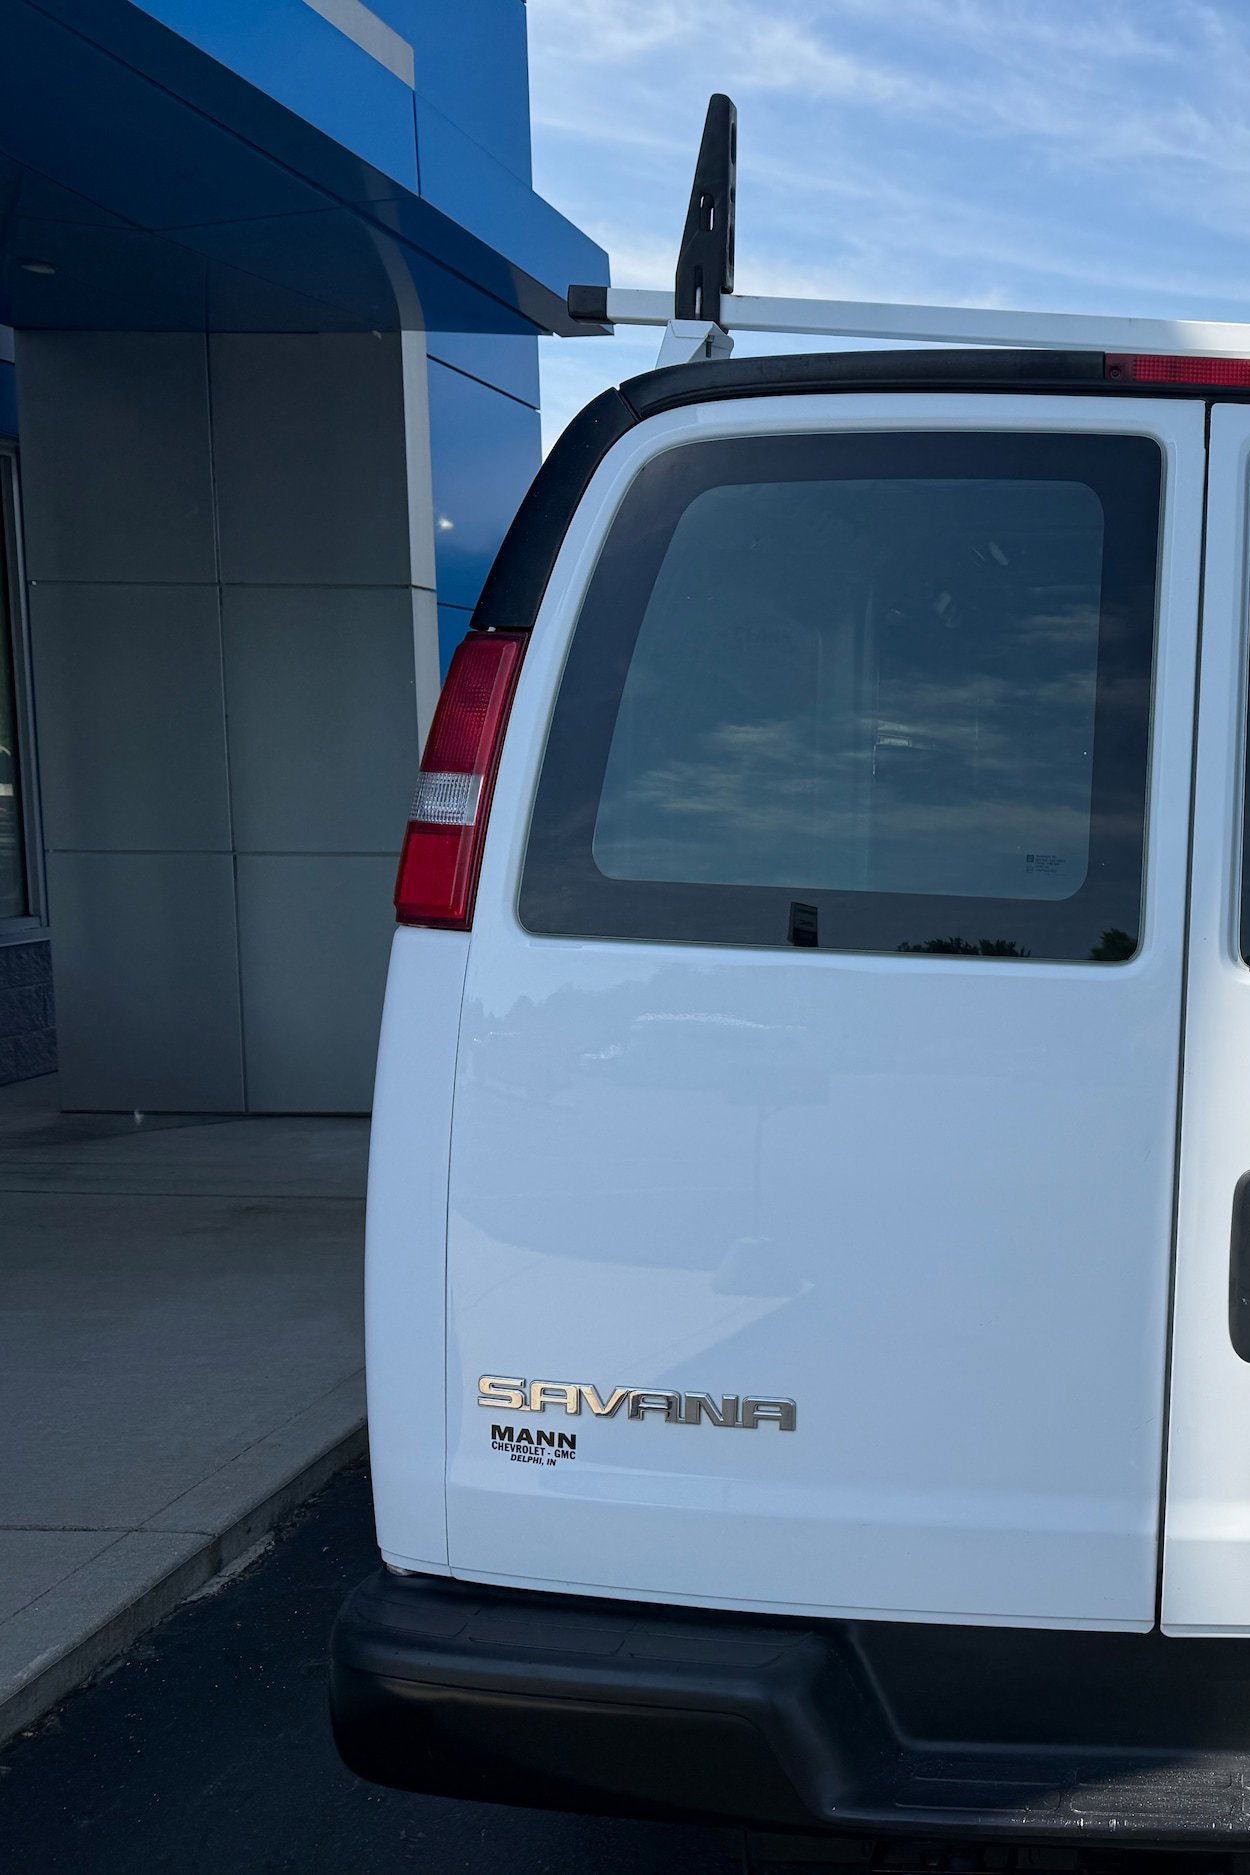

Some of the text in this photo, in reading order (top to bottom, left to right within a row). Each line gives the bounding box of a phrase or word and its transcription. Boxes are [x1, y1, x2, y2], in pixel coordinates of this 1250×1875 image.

[478, 1375, 797, 1431] SAVANA
[491, 1424, 576, 1450] MANN
[491, 1441, 545, 1456] CHEVROLET
[554, 1449, 576, 1460] GMC
[510, 1454, 557, 1467] DELPHI, IN
